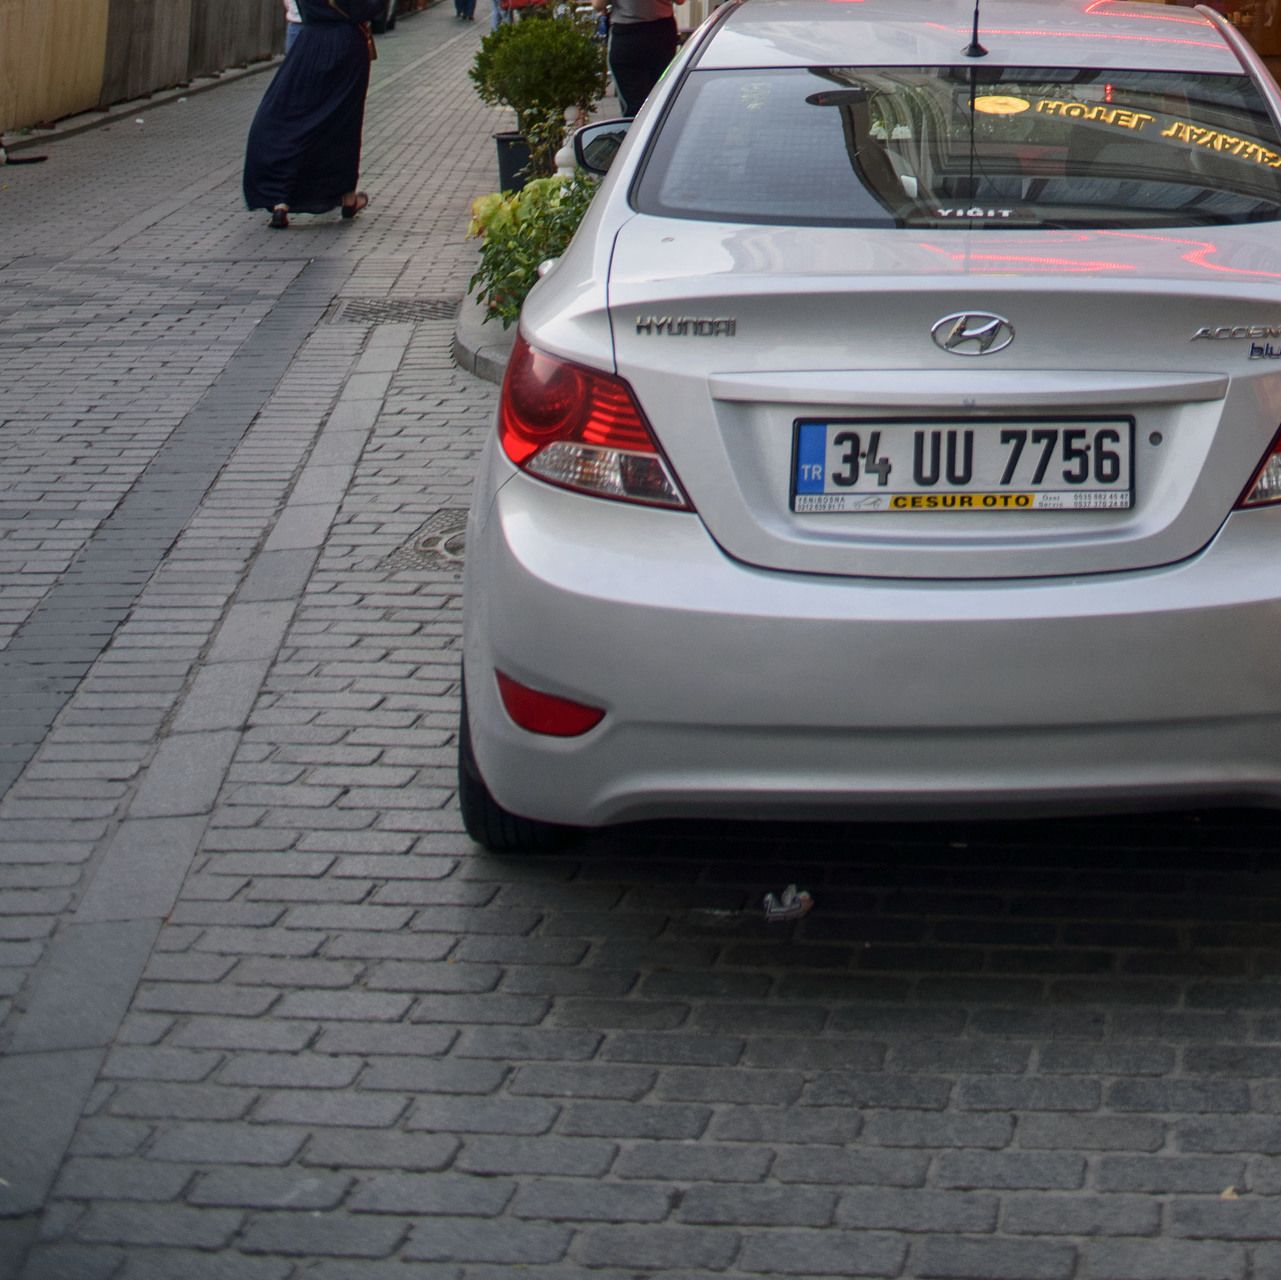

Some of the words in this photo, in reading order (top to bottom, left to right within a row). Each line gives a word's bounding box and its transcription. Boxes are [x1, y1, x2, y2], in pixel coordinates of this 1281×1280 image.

[635, 316, 737, 337] HYUNDAI
[831, 431, 892, 487] 34
[913, 430, 974, 486] UU
[1000, 429, 1121, 485] 7756
[801, 465, 823, 481] TR
[893, 495, 977, 509] CESUR
[982, 494, 1031, 508] OTO
